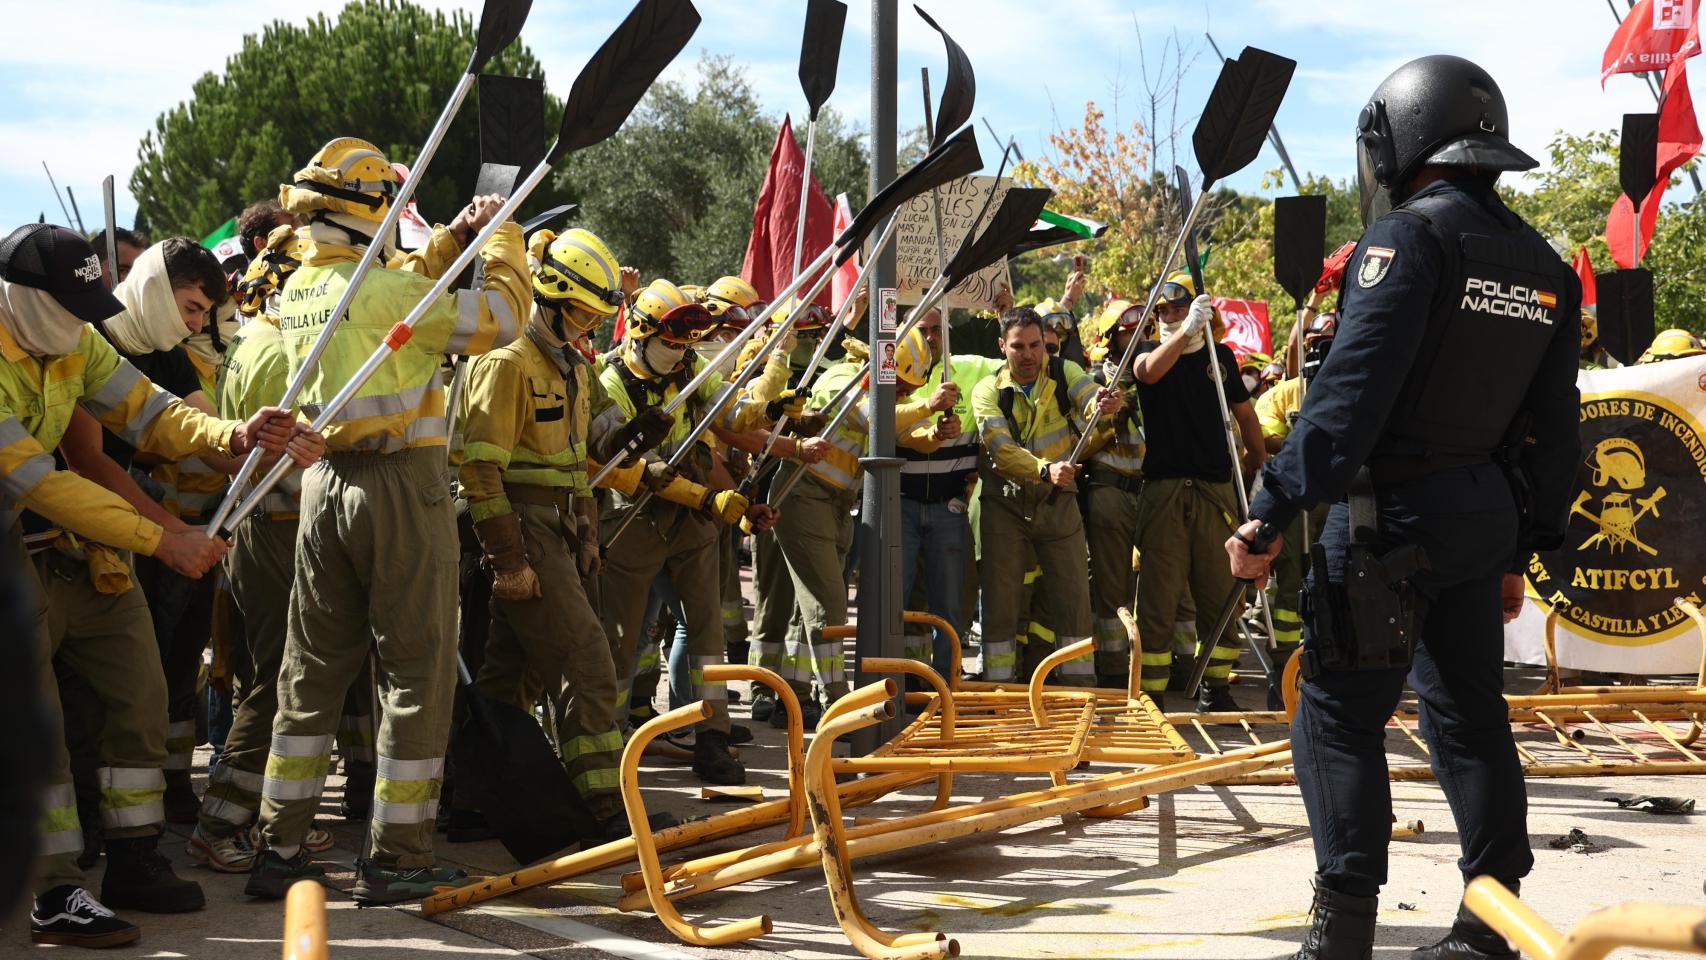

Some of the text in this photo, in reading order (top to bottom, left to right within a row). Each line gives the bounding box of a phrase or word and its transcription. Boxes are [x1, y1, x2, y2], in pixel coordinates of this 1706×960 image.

[903, 213, 930, 224] LUCHA
[942, 217, 958, 229] ON
[917, 224, 924, 234] Y
[74, 264, 101, 278] NORTH
[84, 254, 98, 267] THE
[287, 283, 329, 302] JUNTA DE
[280, 304, 350, 330] ASTILLA Y LEN
[1460, 295, 1553, 326] NACIONAL
[1633, 402, 1656, 421] DE
[1659, 411, 1706, 484] INCENDIO
[1571, 566, 1680, 590] ATIFCYL
[1570, 606, 1648, 634] CASTILLA
[1648, 615, 1662, 630] Y
[1663, 591, 1702, 626] LEN
